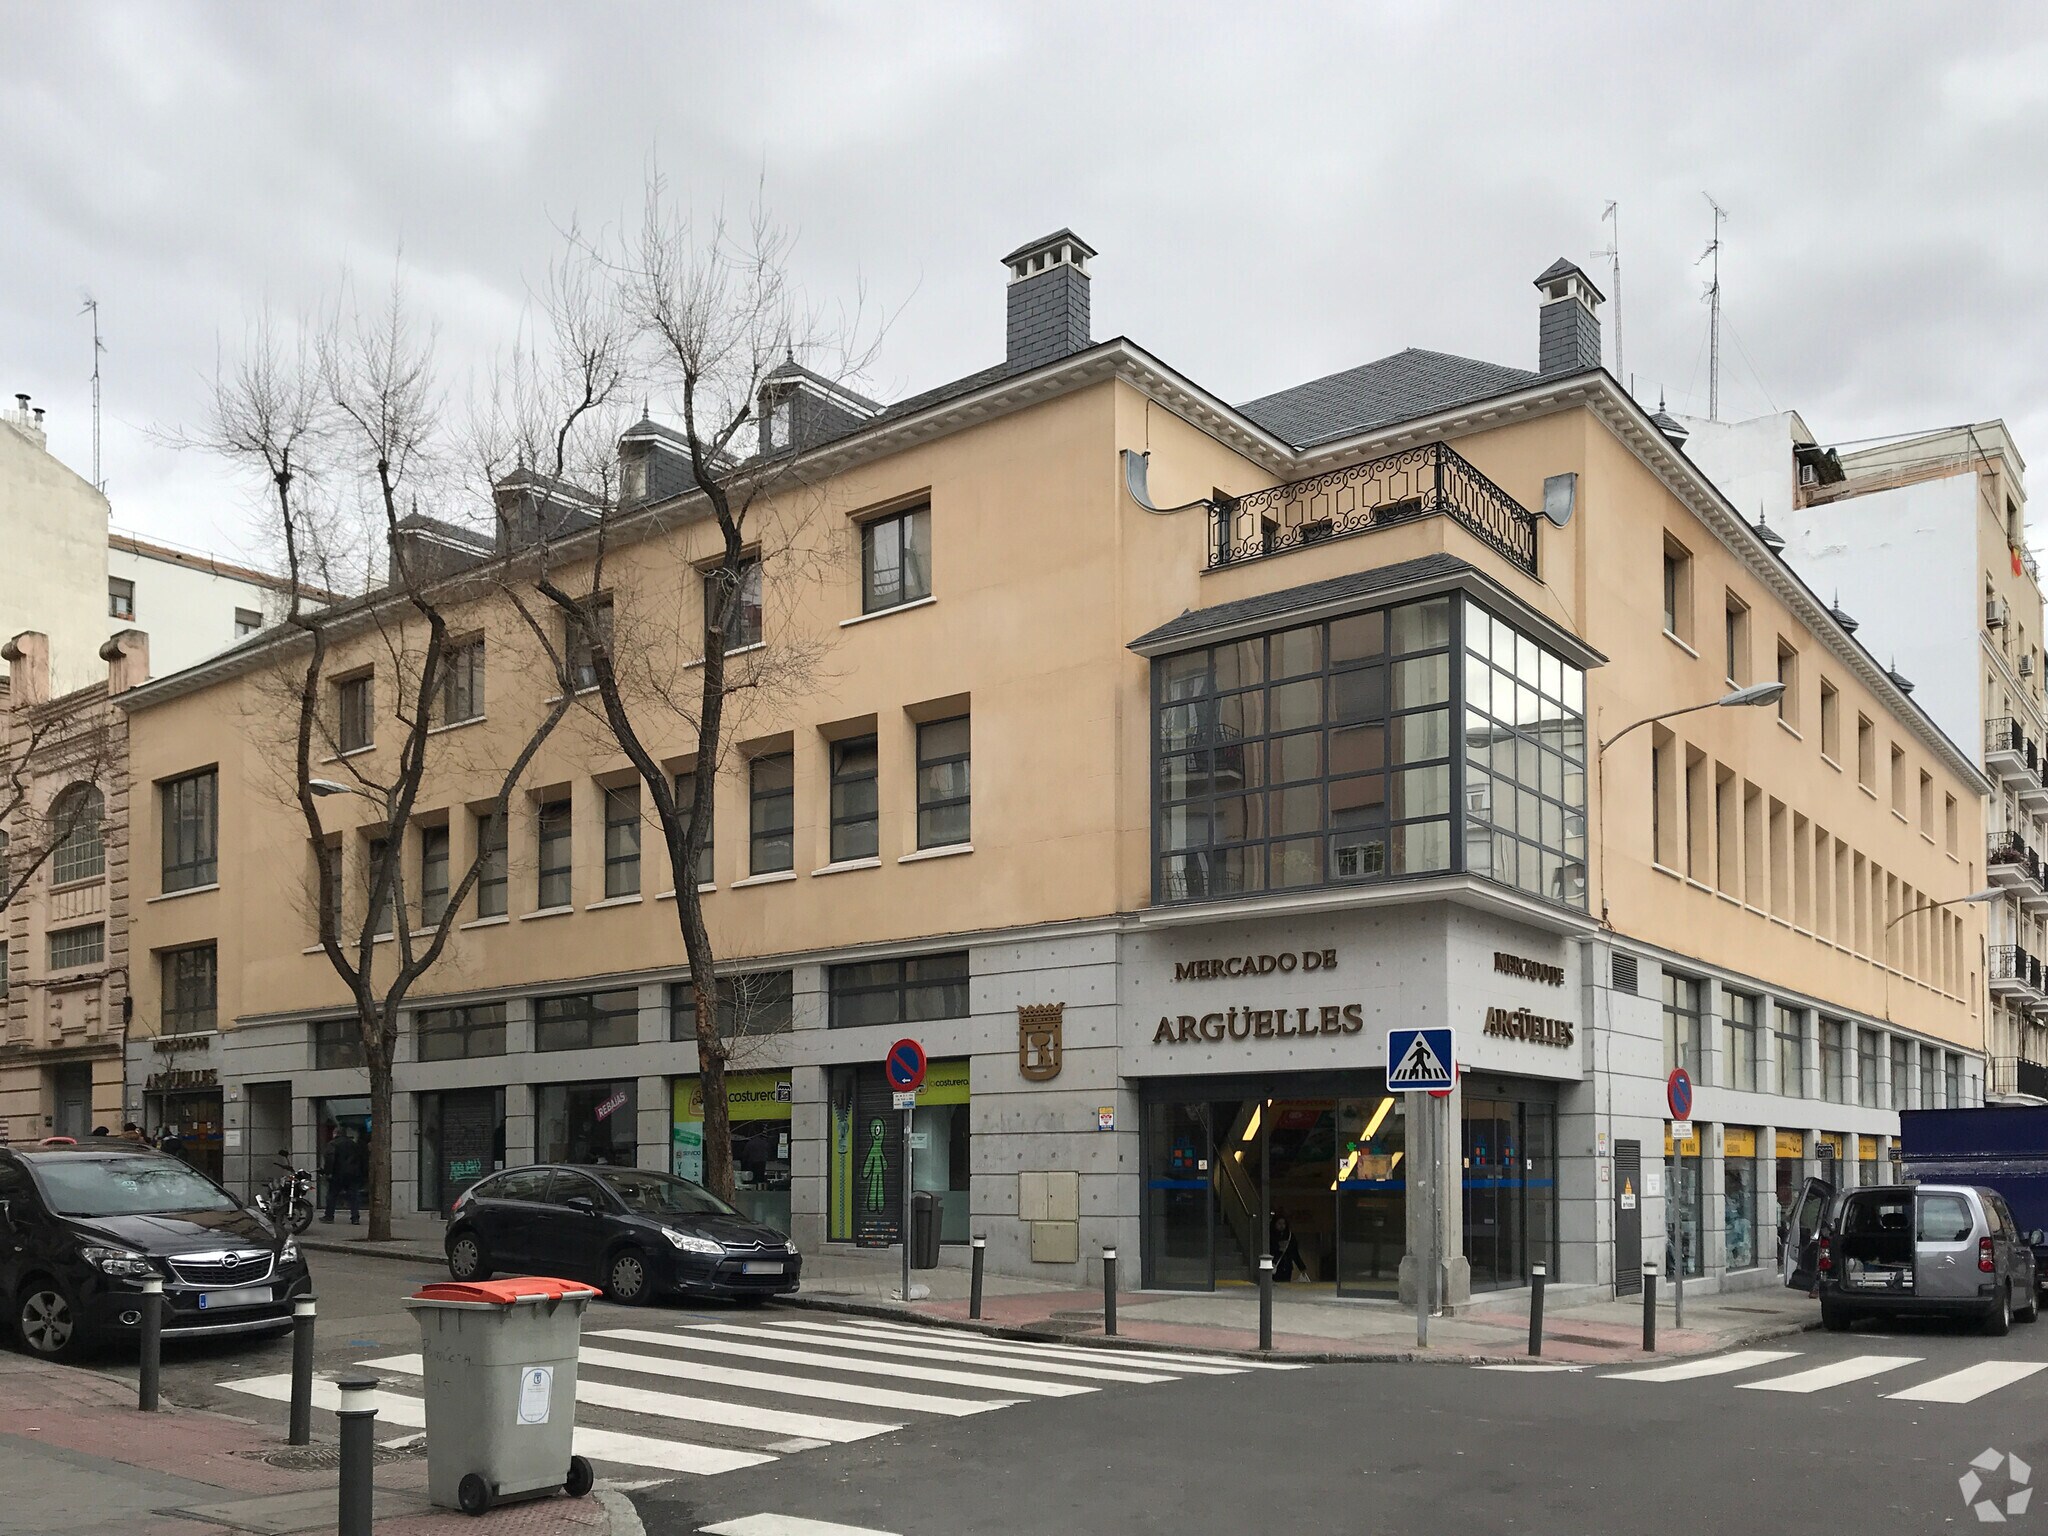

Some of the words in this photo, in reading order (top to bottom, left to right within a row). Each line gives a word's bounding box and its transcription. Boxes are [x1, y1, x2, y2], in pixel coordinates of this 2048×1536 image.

[1175, 952, 1298, 981] MERCADO
[1301, 948, 1338, 971] DE
[1153, 1003, 1363, 1043] ARGÜELLES
[1483, 1006, 1575, 1049] ARGÜELLES
[597, 1091, 626, 1118] REBAJAS
